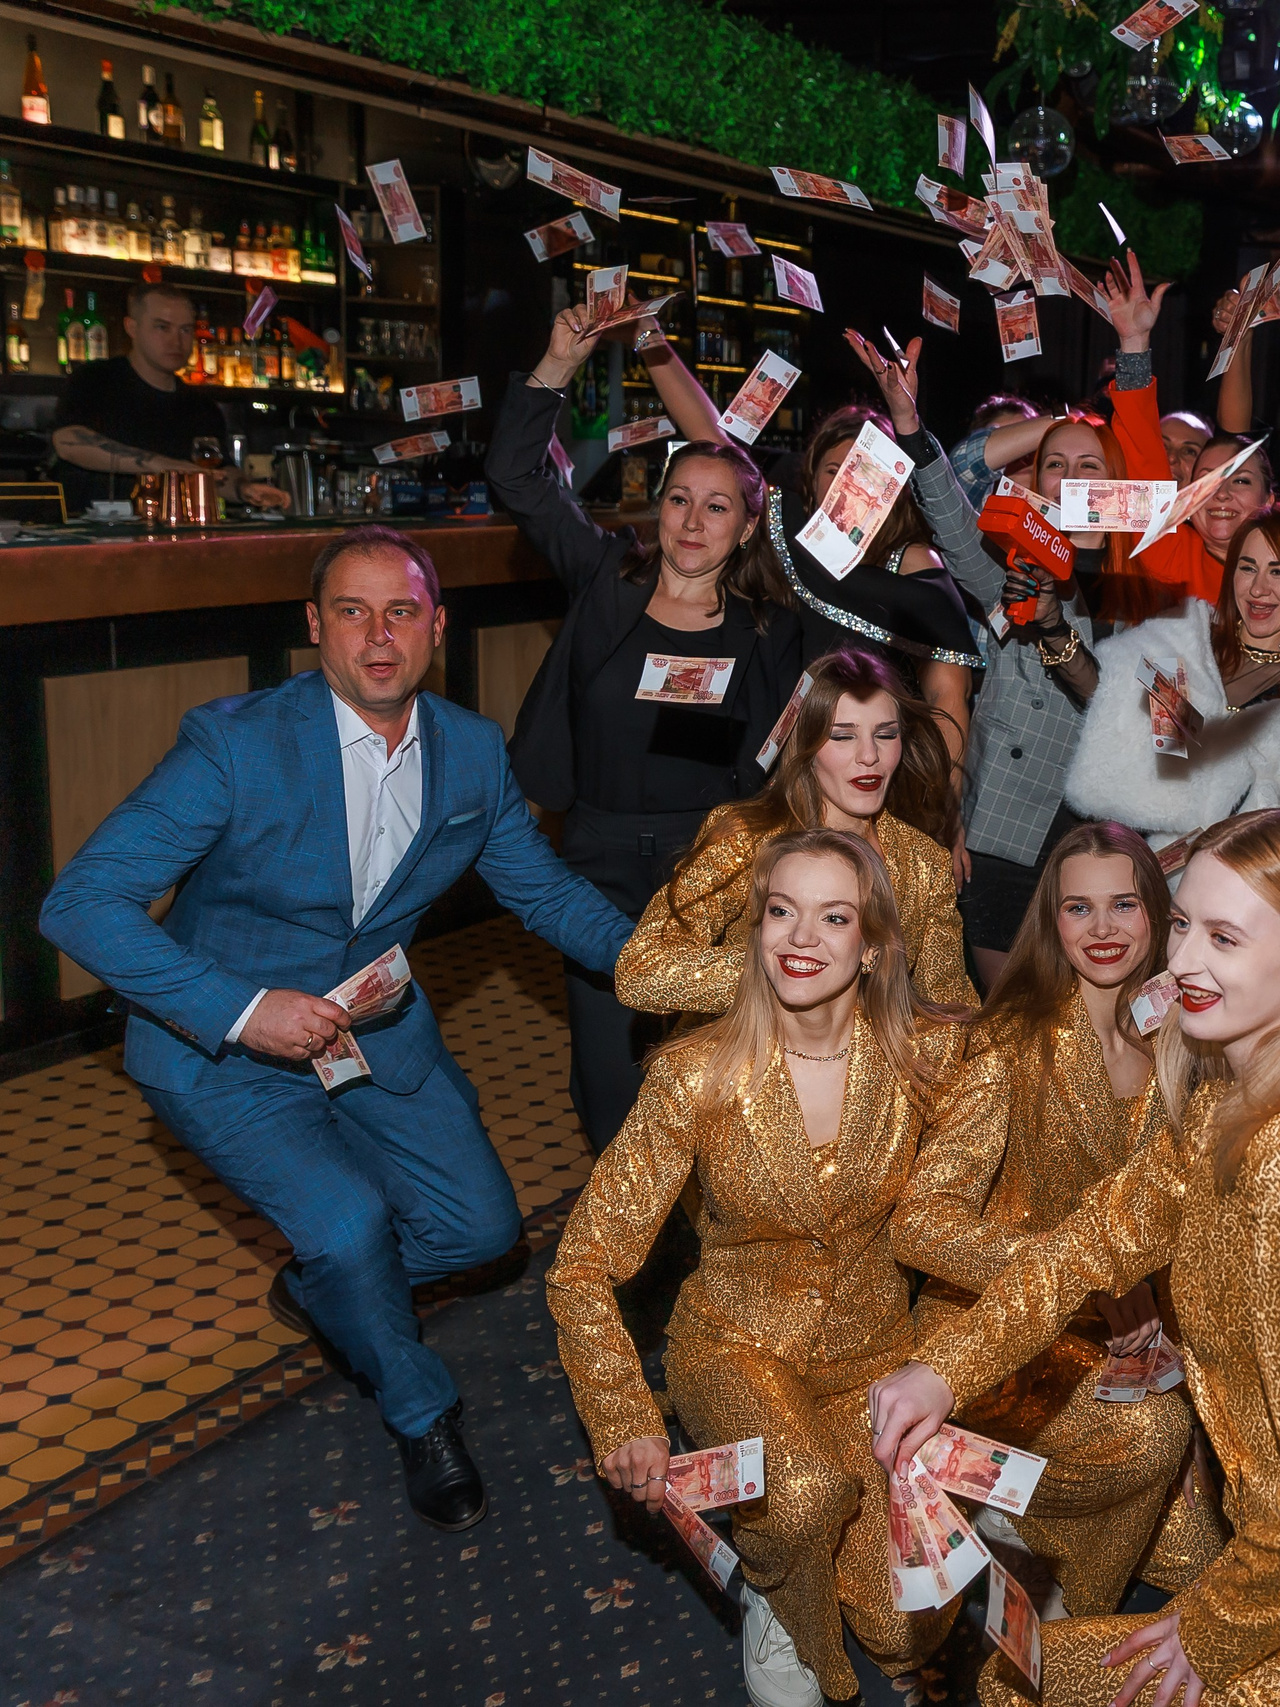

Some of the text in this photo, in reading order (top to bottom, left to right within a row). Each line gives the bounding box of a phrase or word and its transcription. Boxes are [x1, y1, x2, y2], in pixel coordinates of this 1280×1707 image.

[881, 477, 899, 504] 5000
[1131, 520, 1149, 528] 000
[1023, 512, 1070, 563] Super Gun
[1140, 979, 1161, 997] 5000
[714, 1489, 739, 1503] 5000
[898, 1476, 917, 1510] 5000
[915, 1474, 937, 1500] 5000
